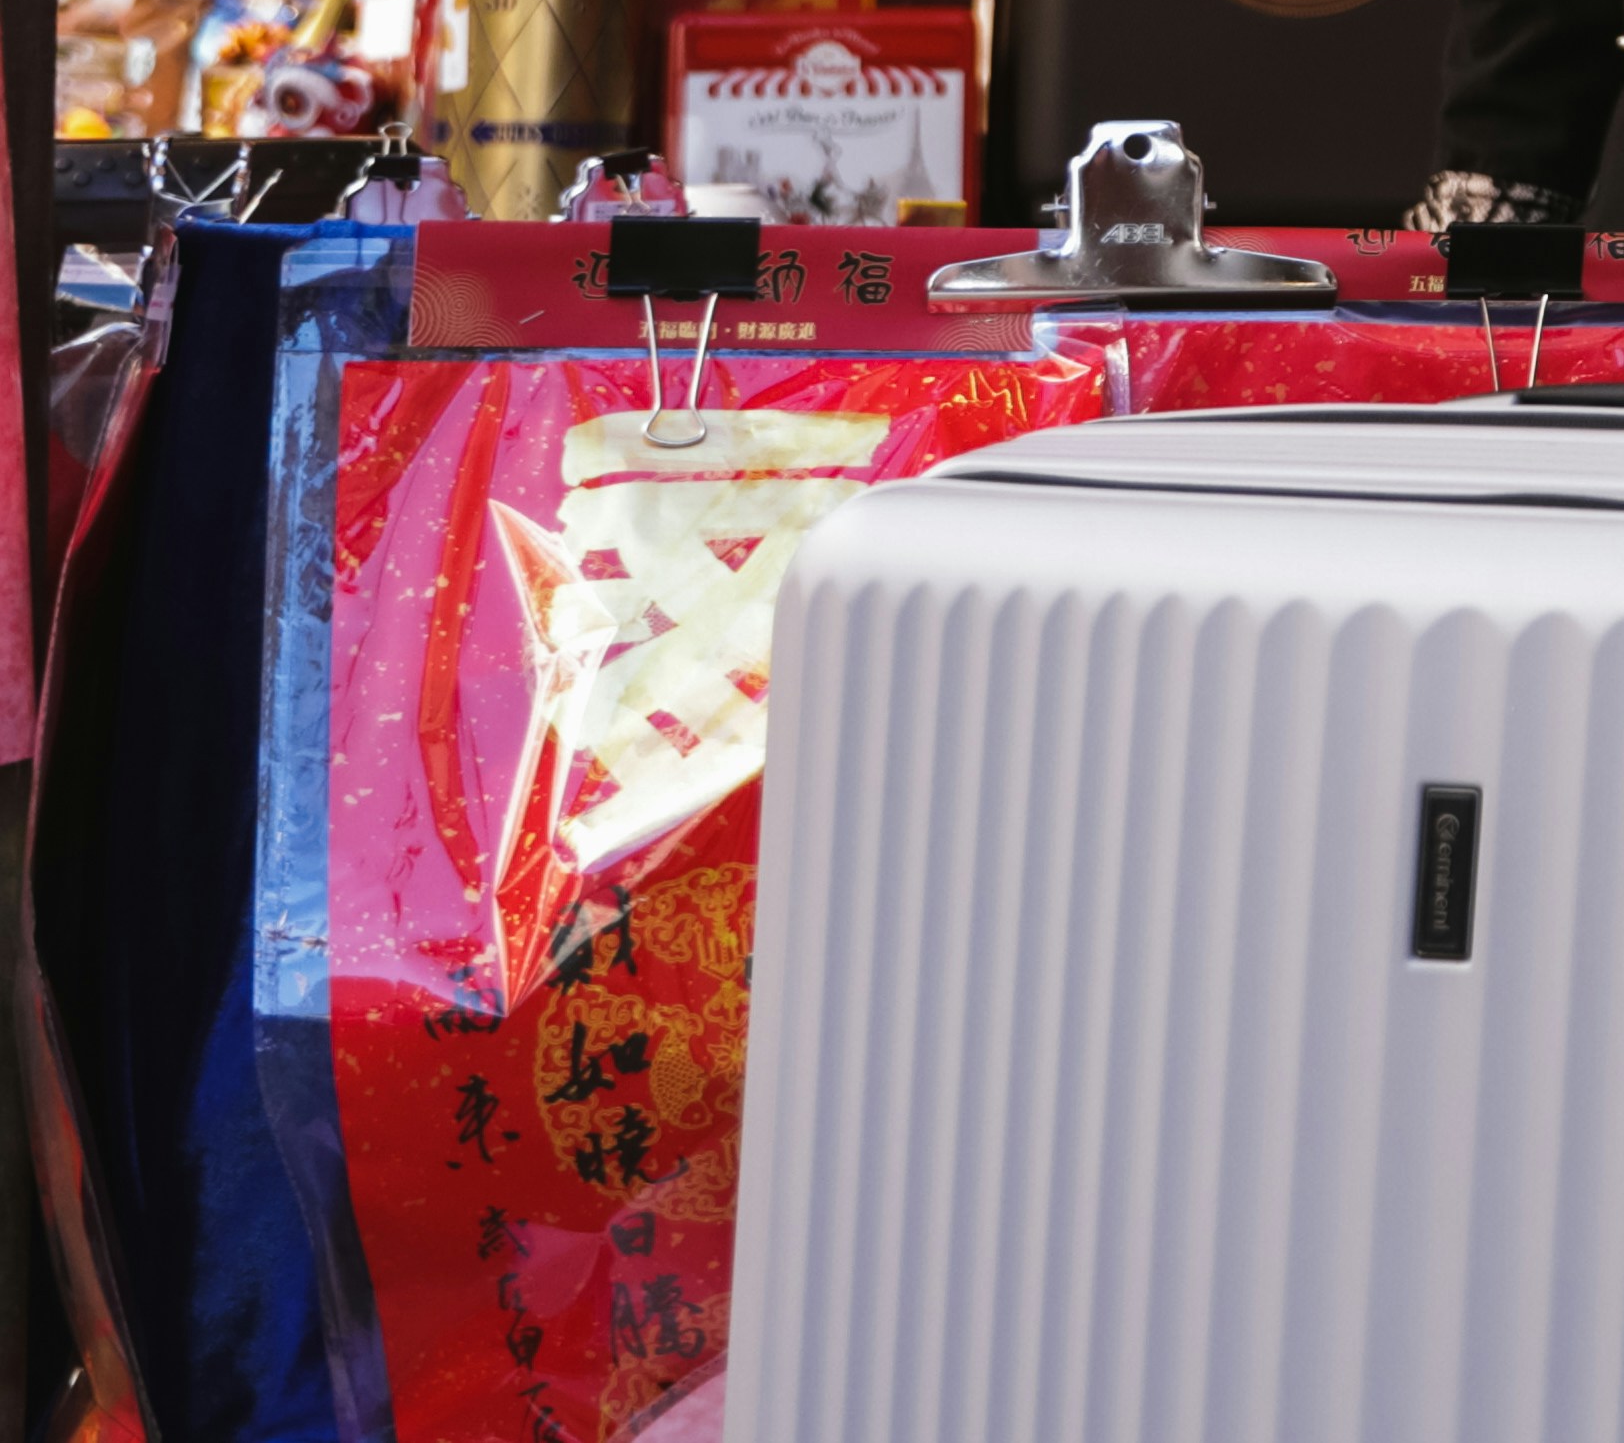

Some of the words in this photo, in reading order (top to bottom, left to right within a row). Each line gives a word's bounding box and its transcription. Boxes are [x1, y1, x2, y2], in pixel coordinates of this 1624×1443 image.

[1100, 223, 1174, 244] ABEL
[572, 250, 894, 306] 迎納福
[1432, 842, 1456, 931] eminent
